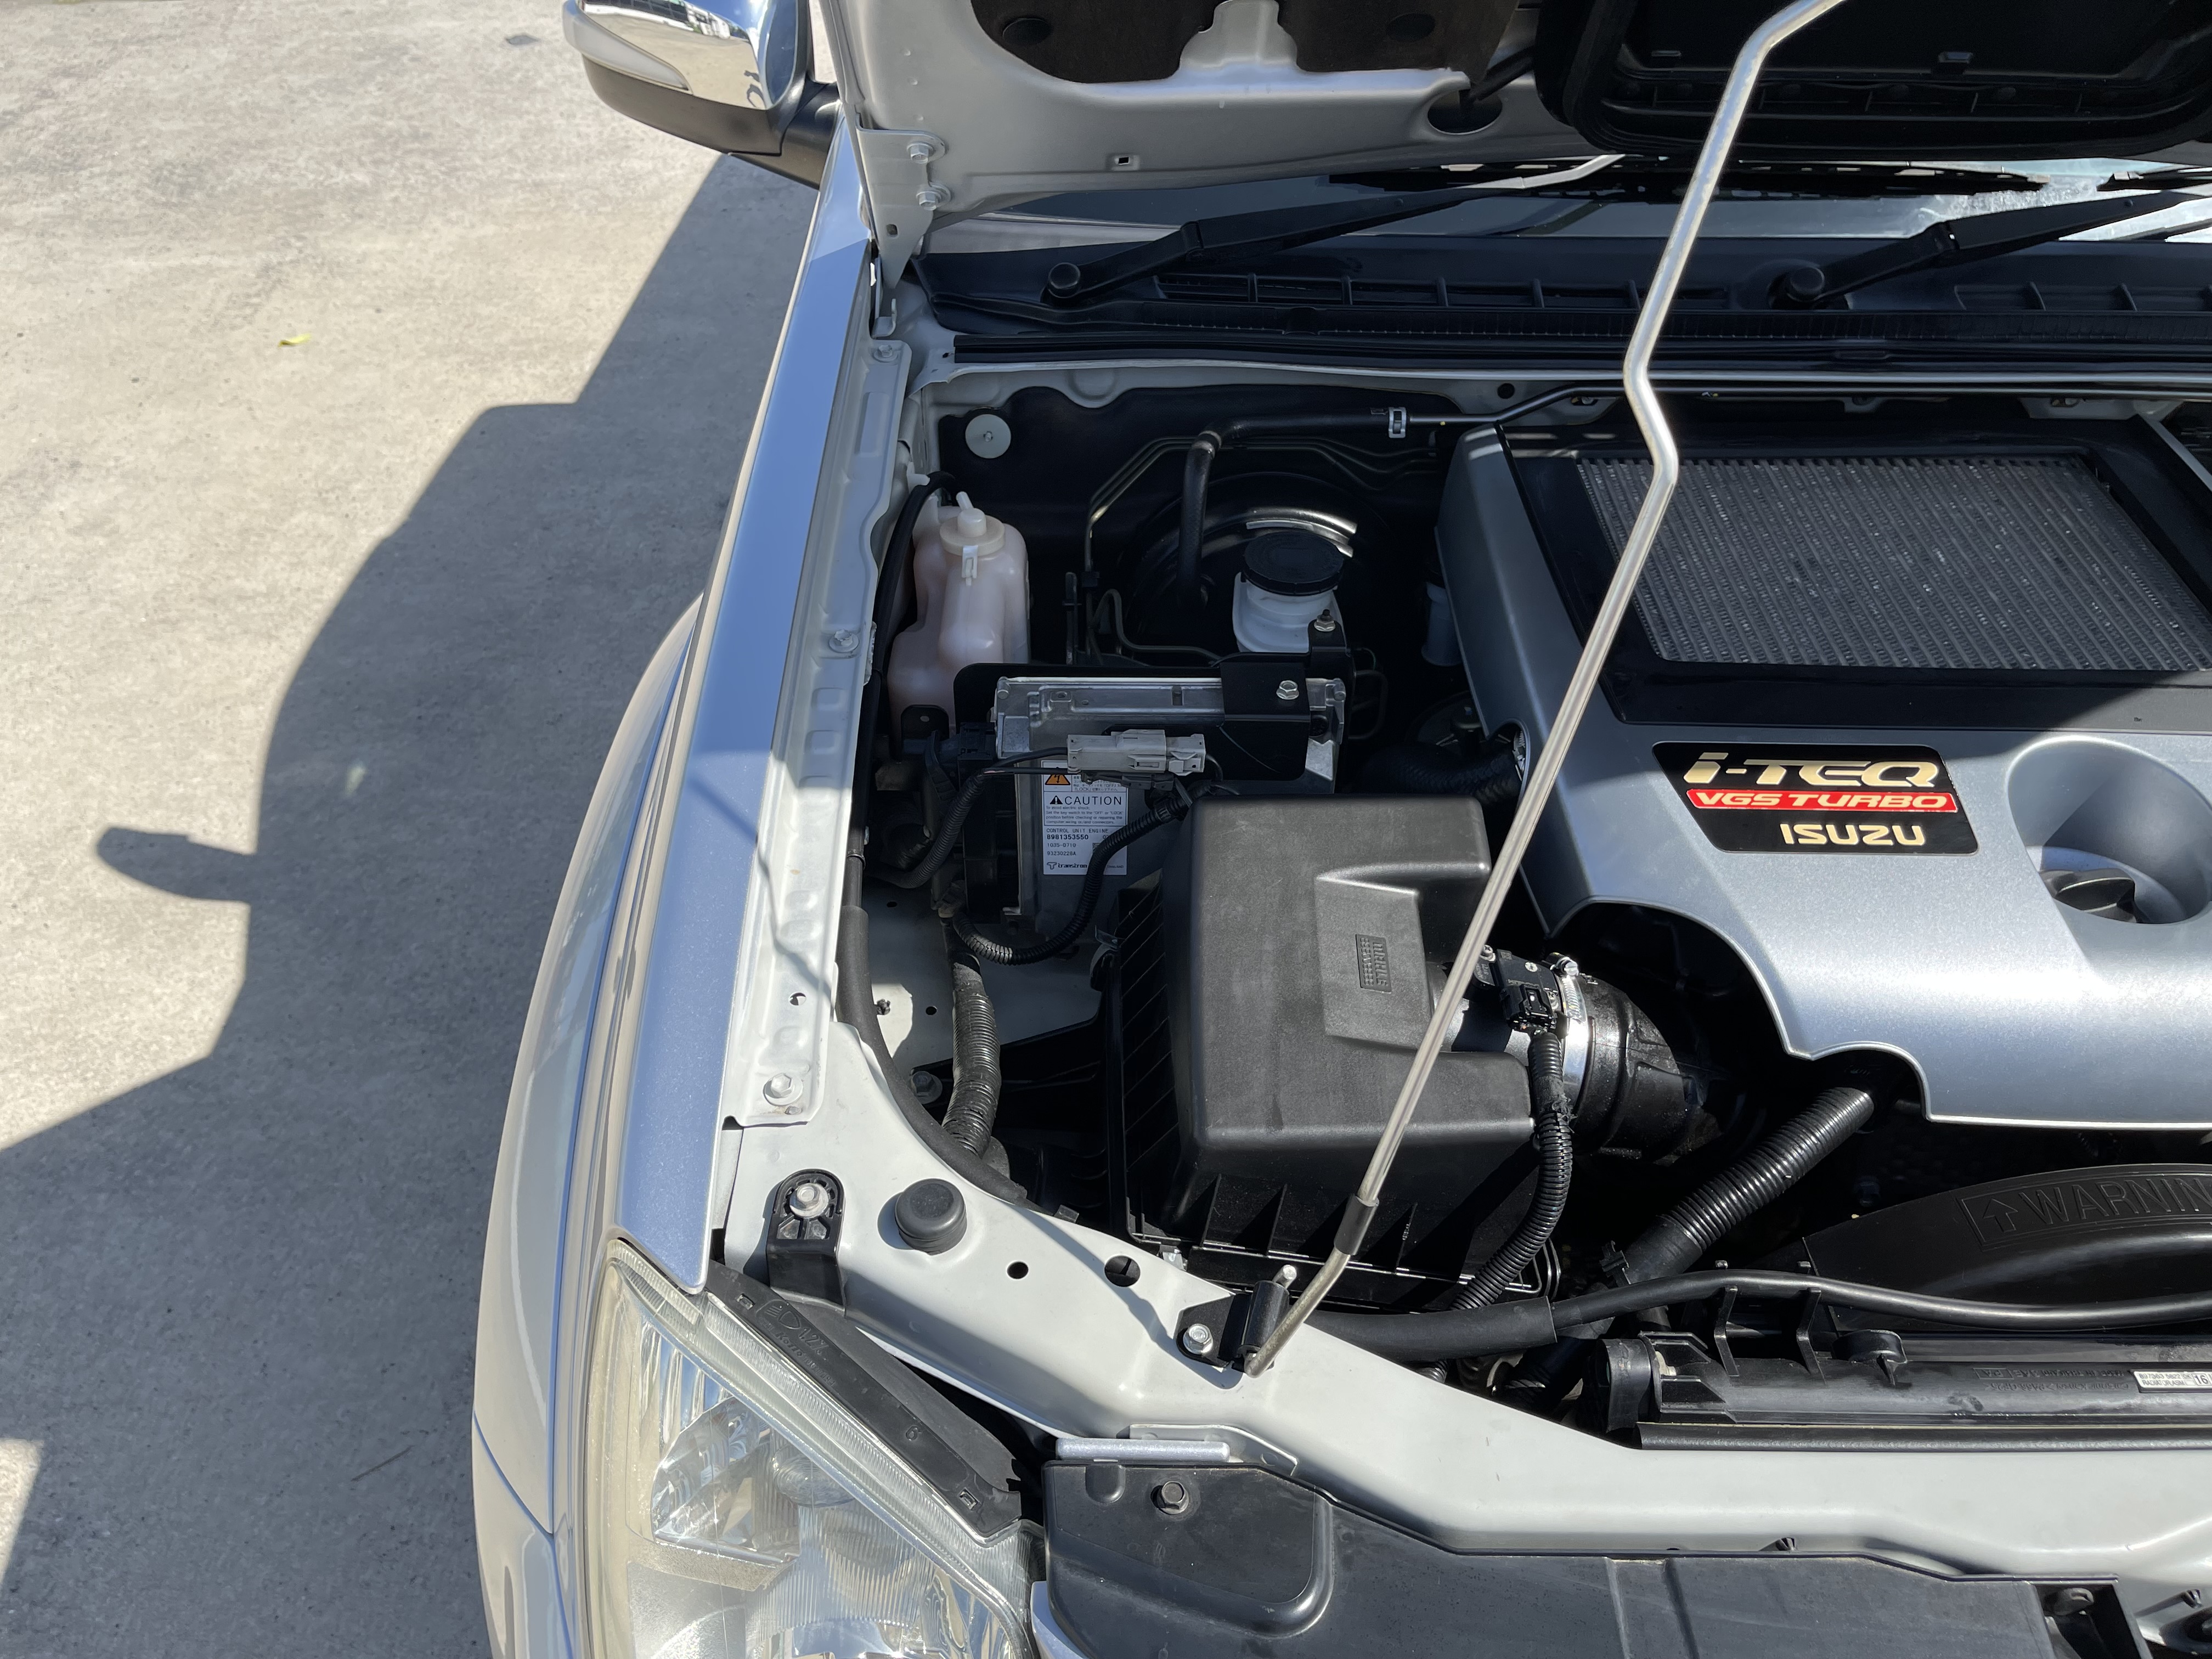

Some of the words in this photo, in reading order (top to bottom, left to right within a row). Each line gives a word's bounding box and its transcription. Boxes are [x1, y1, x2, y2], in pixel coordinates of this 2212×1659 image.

[1683, 752, 1939, 787] i-TEQ
[1064, 796, 1121, 805] CAUTION
[1695, 792, 1783, 806] VGS
[1789, 794, 1948, 809] TURBO
[1780, 823, 1926, 846] ISUZU
[2194, 1375, 2209, 1384] 16
